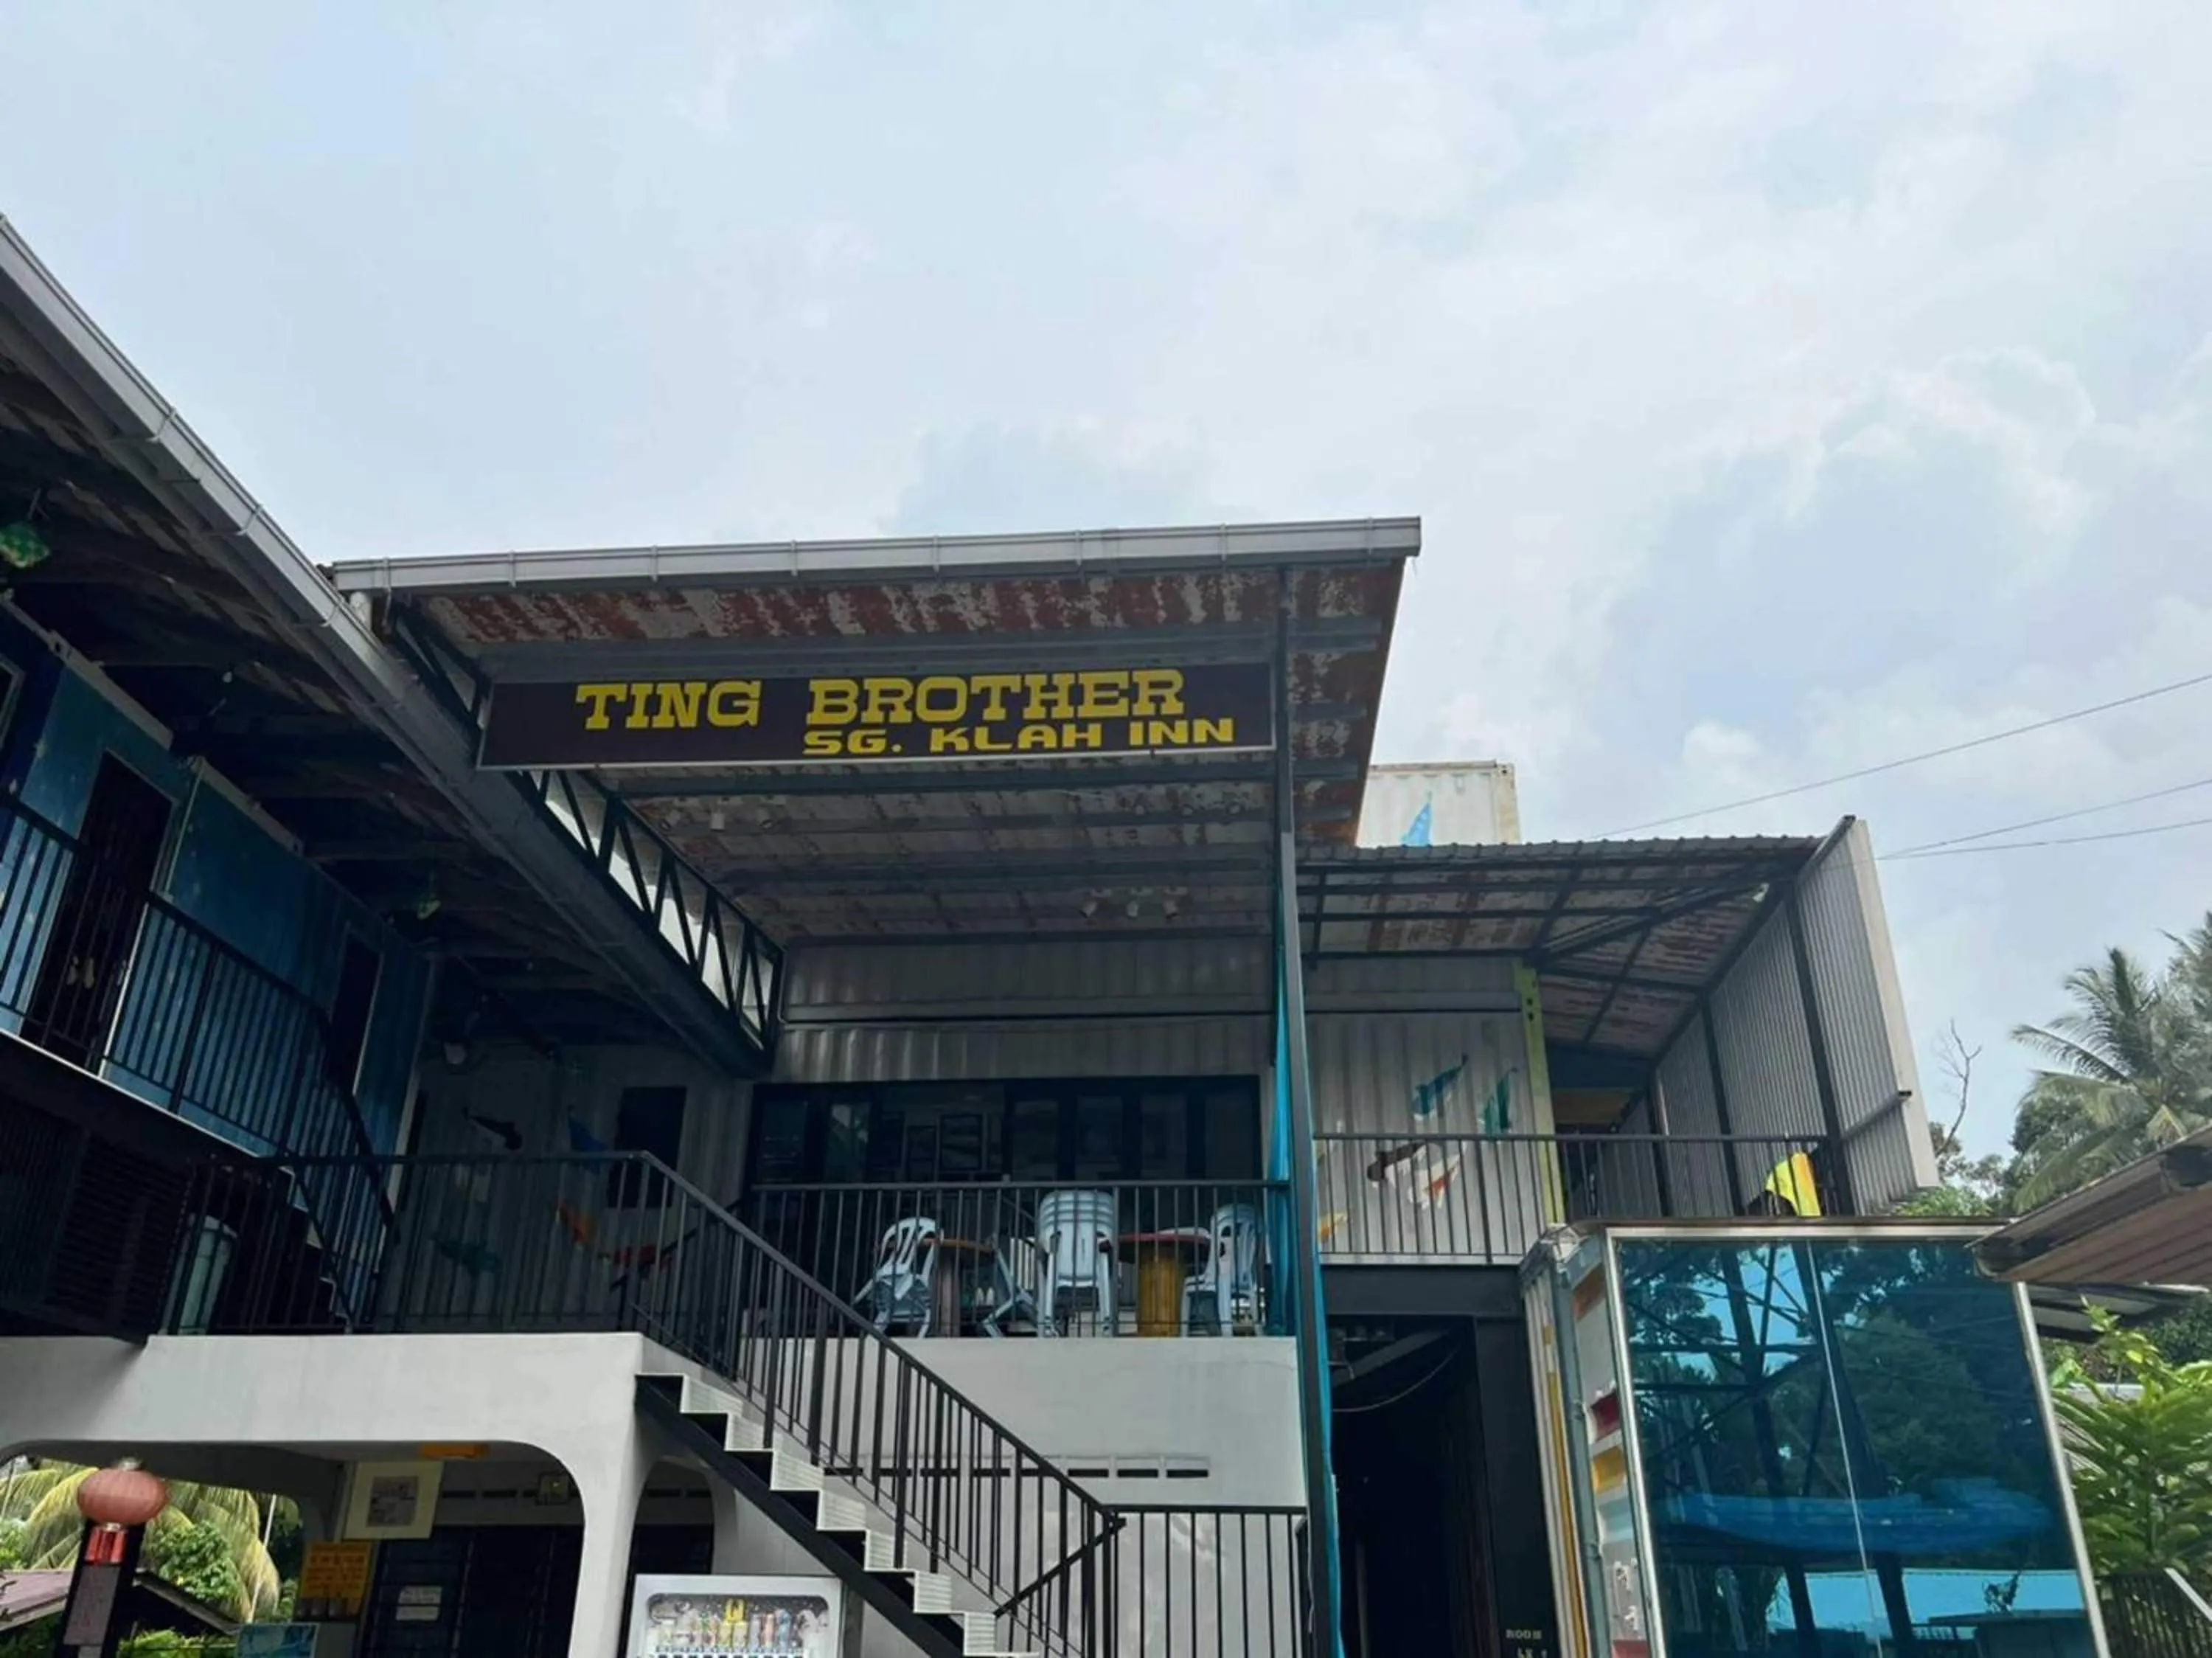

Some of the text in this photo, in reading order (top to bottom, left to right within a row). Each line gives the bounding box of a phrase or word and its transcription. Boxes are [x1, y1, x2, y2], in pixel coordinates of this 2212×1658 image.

[575, 669, 1184, 729] TING BROTHER
[802, 718, 1234, 755] SG. KLAH INN
